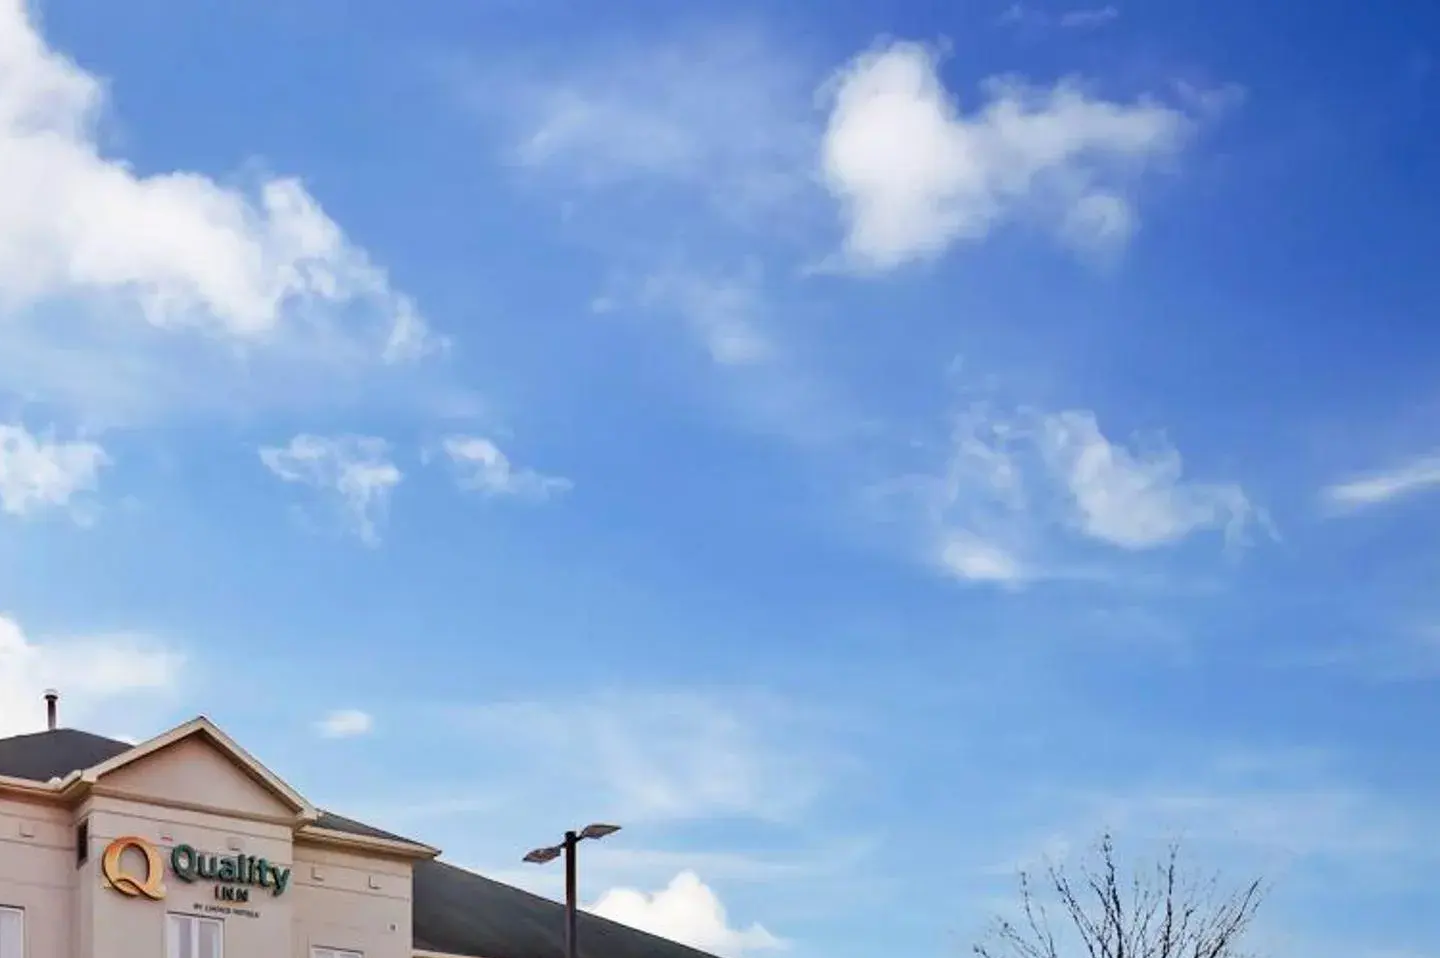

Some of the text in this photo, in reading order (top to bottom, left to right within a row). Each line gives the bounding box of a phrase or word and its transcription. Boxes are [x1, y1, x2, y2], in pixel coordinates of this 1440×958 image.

[101, 837, 166, 901] Q
[171, 844, 290, 897] Quality
[214, 885, 249, 902] INN
